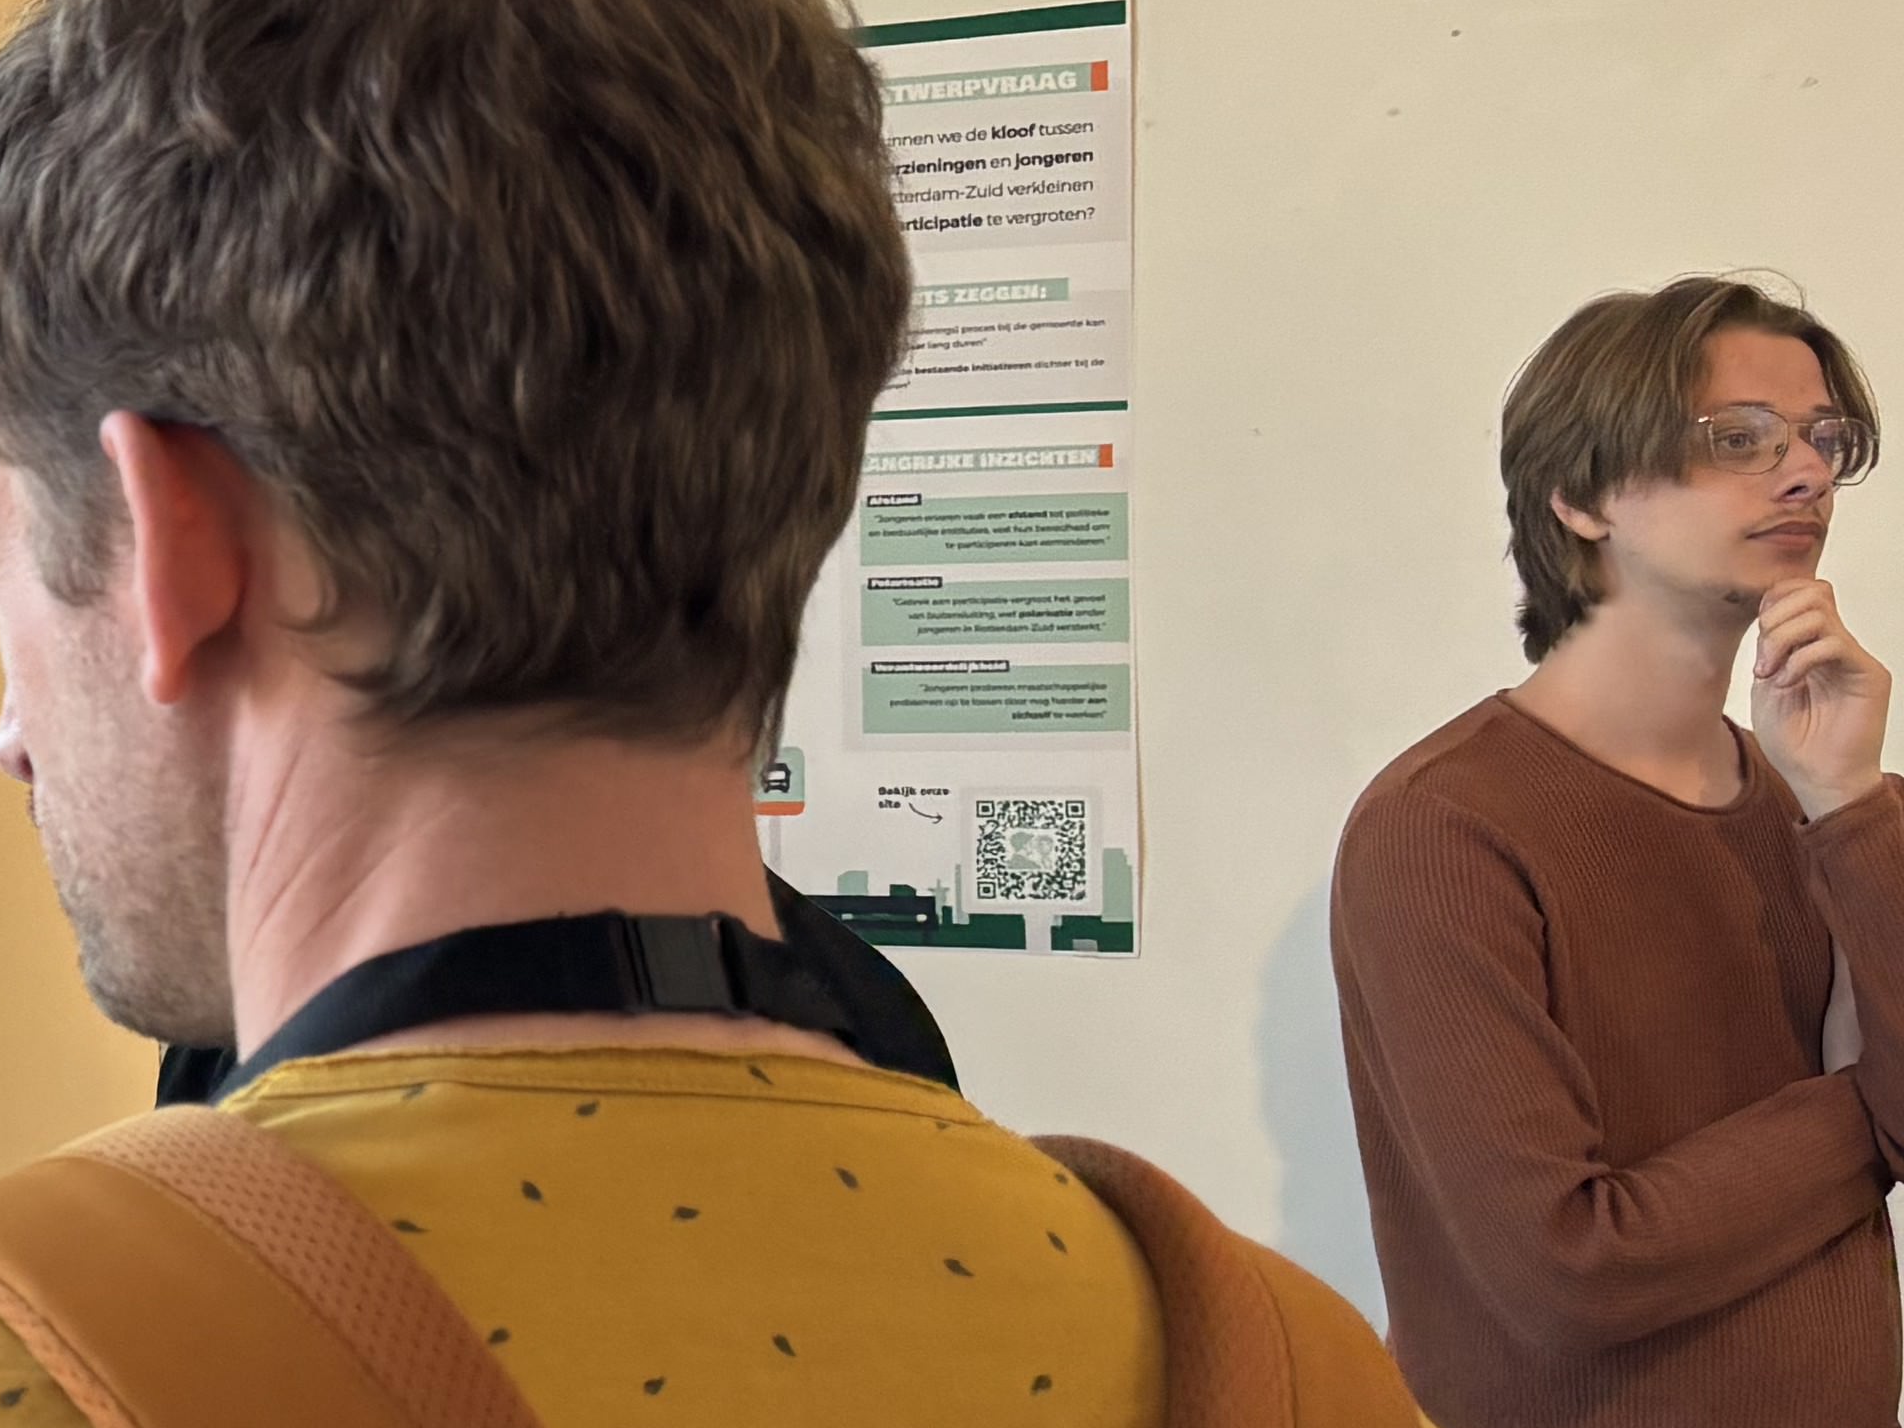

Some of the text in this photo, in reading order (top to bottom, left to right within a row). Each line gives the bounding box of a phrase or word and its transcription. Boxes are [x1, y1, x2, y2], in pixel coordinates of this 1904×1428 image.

[937, 132, 962, 143] we
[965, 127, 988, 142] de
[991, 123, 1036, 140] kloof
[1039, 121, 1094, 137] tussen
[895, 151, 1094, 176] rzieningen en jongeren
[1007, 178, 1094, 195] verkleinen
[903, 206, 1096, 232] rticipatie te vergroten?
[953, 284, 1048, 303] ZEGGEN:
[863, 448, 1097, 473] ANGRIJKE INZICHTEN
